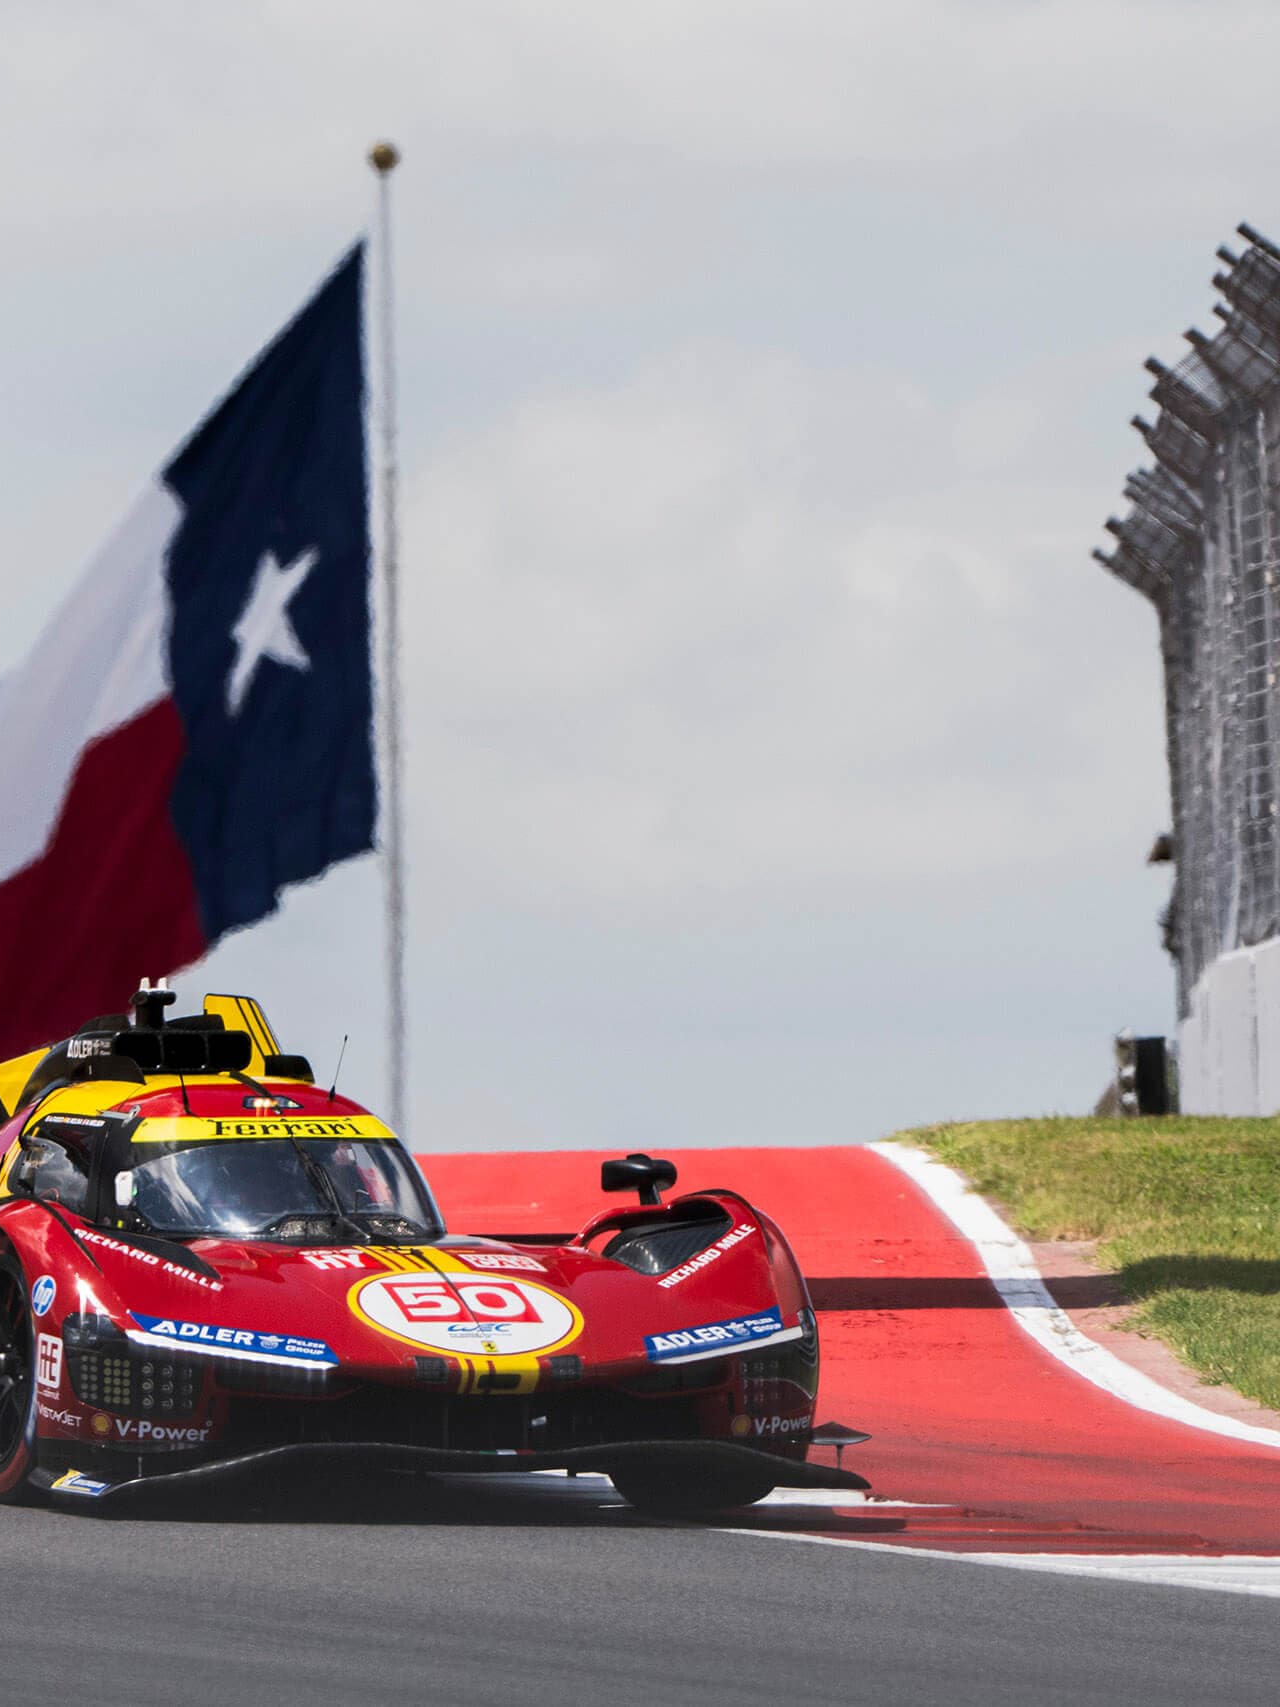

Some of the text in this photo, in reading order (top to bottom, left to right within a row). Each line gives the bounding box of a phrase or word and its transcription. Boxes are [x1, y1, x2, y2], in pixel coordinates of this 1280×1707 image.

[207, 1117, 365, 1136] Ferrari
[73, 1227, 225, 1292] RICHARD MILLE
[657, 1223, 757, 1289] RICHARD MILLE
[390, 1285, 528, 1318] 50
[149, 1320, 256, 1346] ADLER
[651, 1326, 734, 1352] ADLER
[115, 1418, 209, 1442] V-Power
[753, 1414, 812, 1435] V-Power
